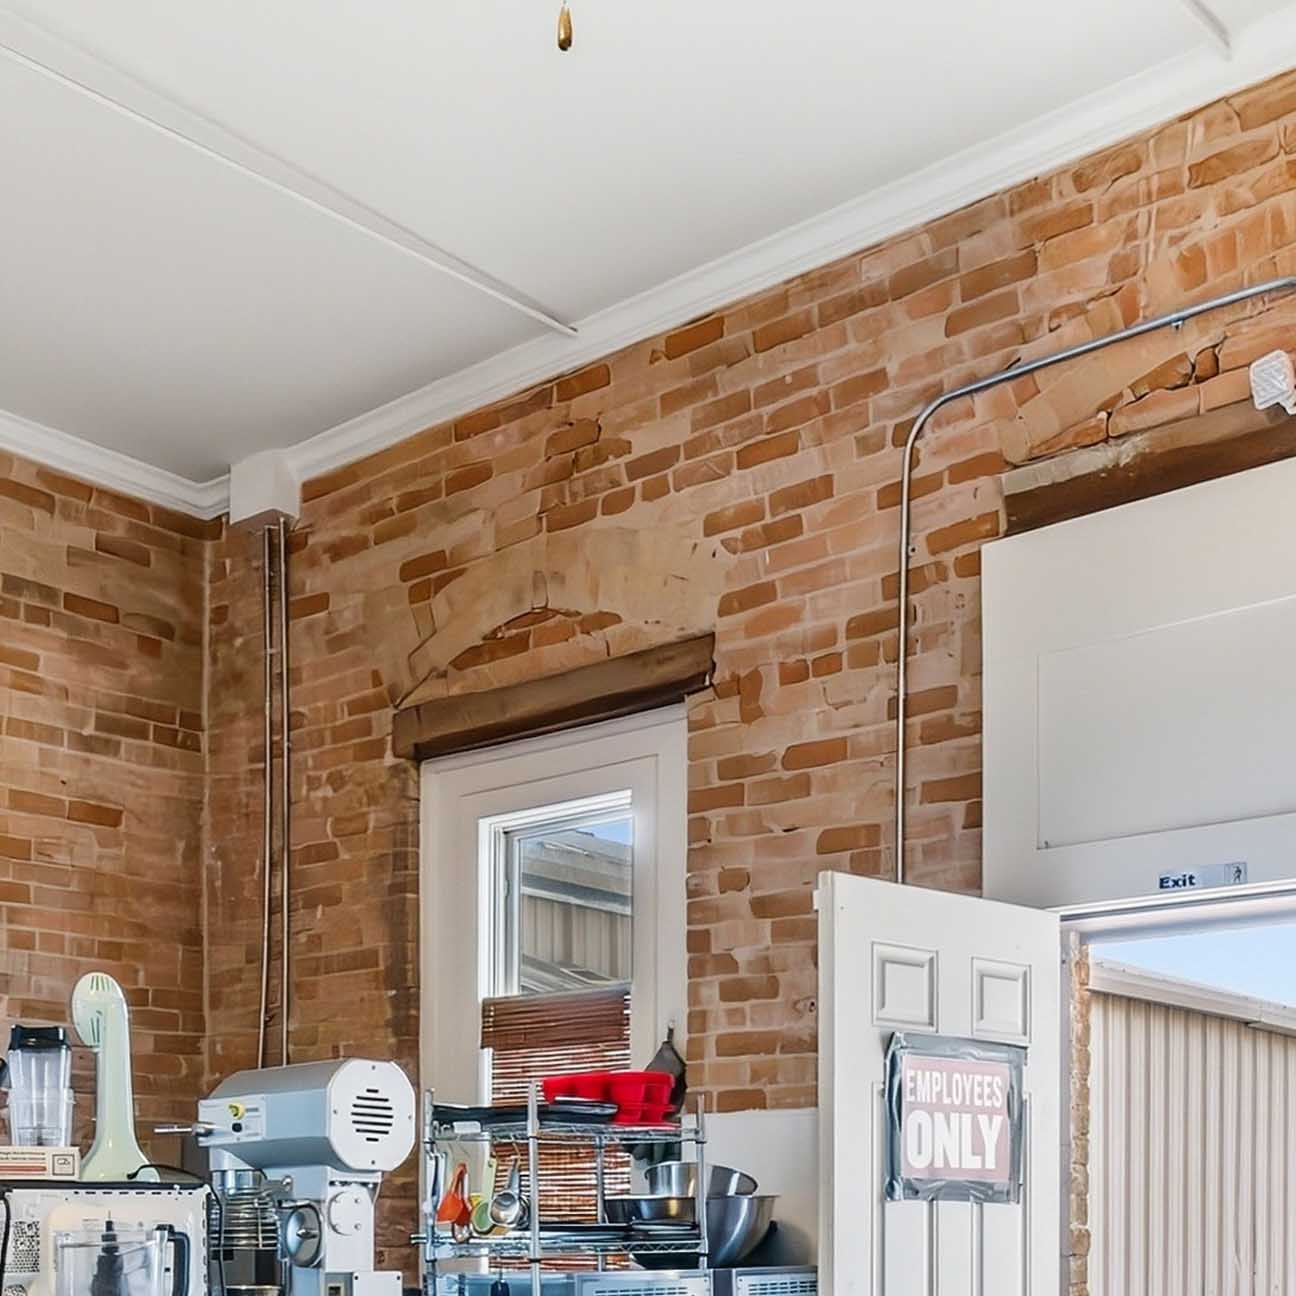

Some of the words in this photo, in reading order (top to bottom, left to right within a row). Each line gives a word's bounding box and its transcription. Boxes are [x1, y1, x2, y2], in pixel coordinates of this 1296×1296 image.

[1159, 873, 1197, 890] Exit
[905, 1069, 1003, 1108] EMPLOYEES
[906, 1109, 1004, 1170] ONLY
